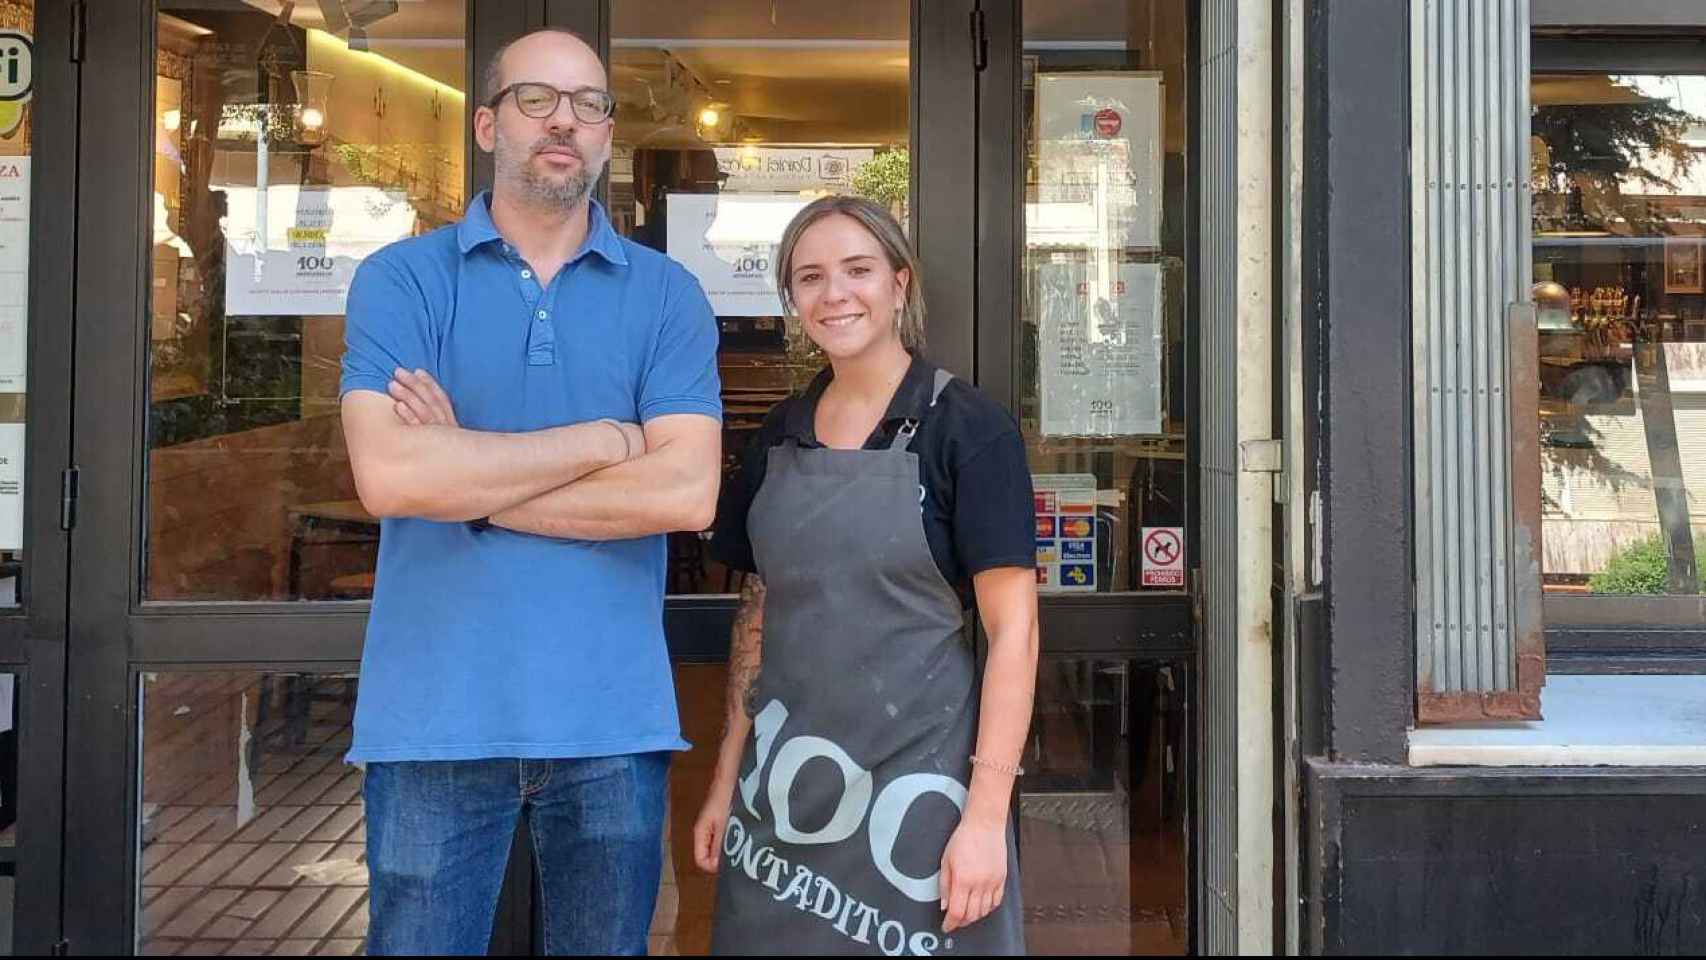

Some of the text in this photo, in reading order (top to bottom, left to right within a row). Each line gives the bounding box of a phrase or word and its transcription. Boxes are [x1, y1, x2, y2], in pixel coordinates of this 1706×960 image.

[297, 256, 335, 271] 100
[733, 257, 768, 272] 100
[738, 698, 971, 903] 100
